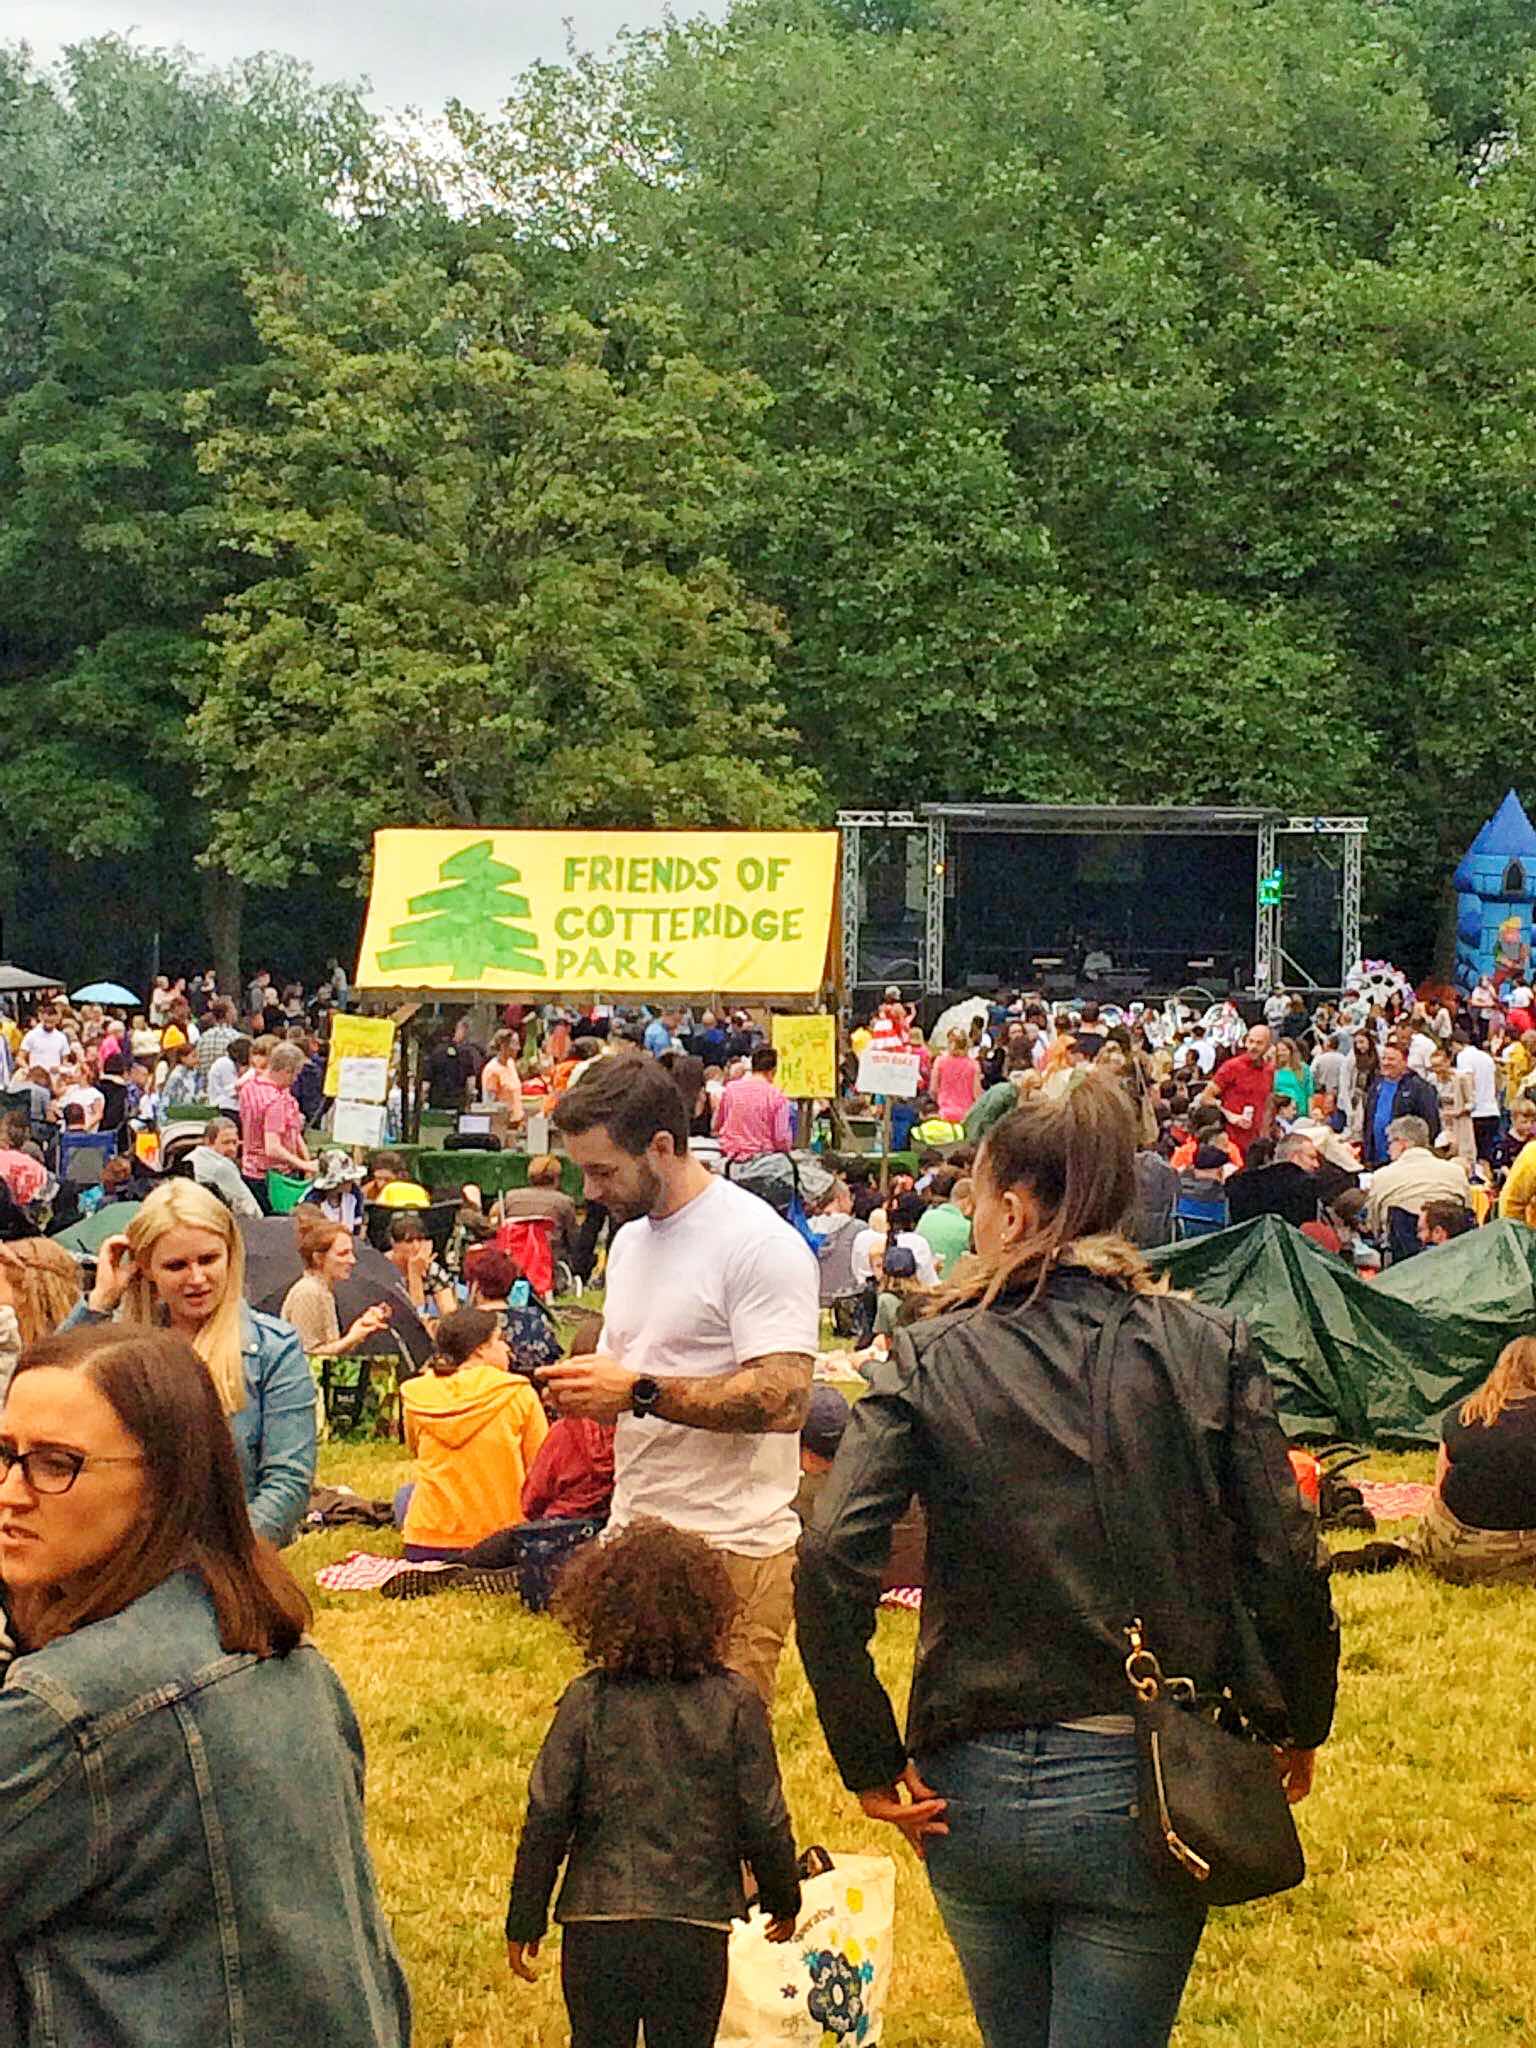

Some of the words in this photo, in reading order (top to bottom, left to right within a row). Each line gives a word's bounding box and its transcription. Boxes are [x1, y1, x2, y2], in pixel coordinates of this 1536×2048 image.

[563, 855, 721, 893] FRIENDS
[737, 856, 791, 893] OF
[554, 903, 805, 942] COTTERIDGE
[555, 946, 678, 980] PARK
